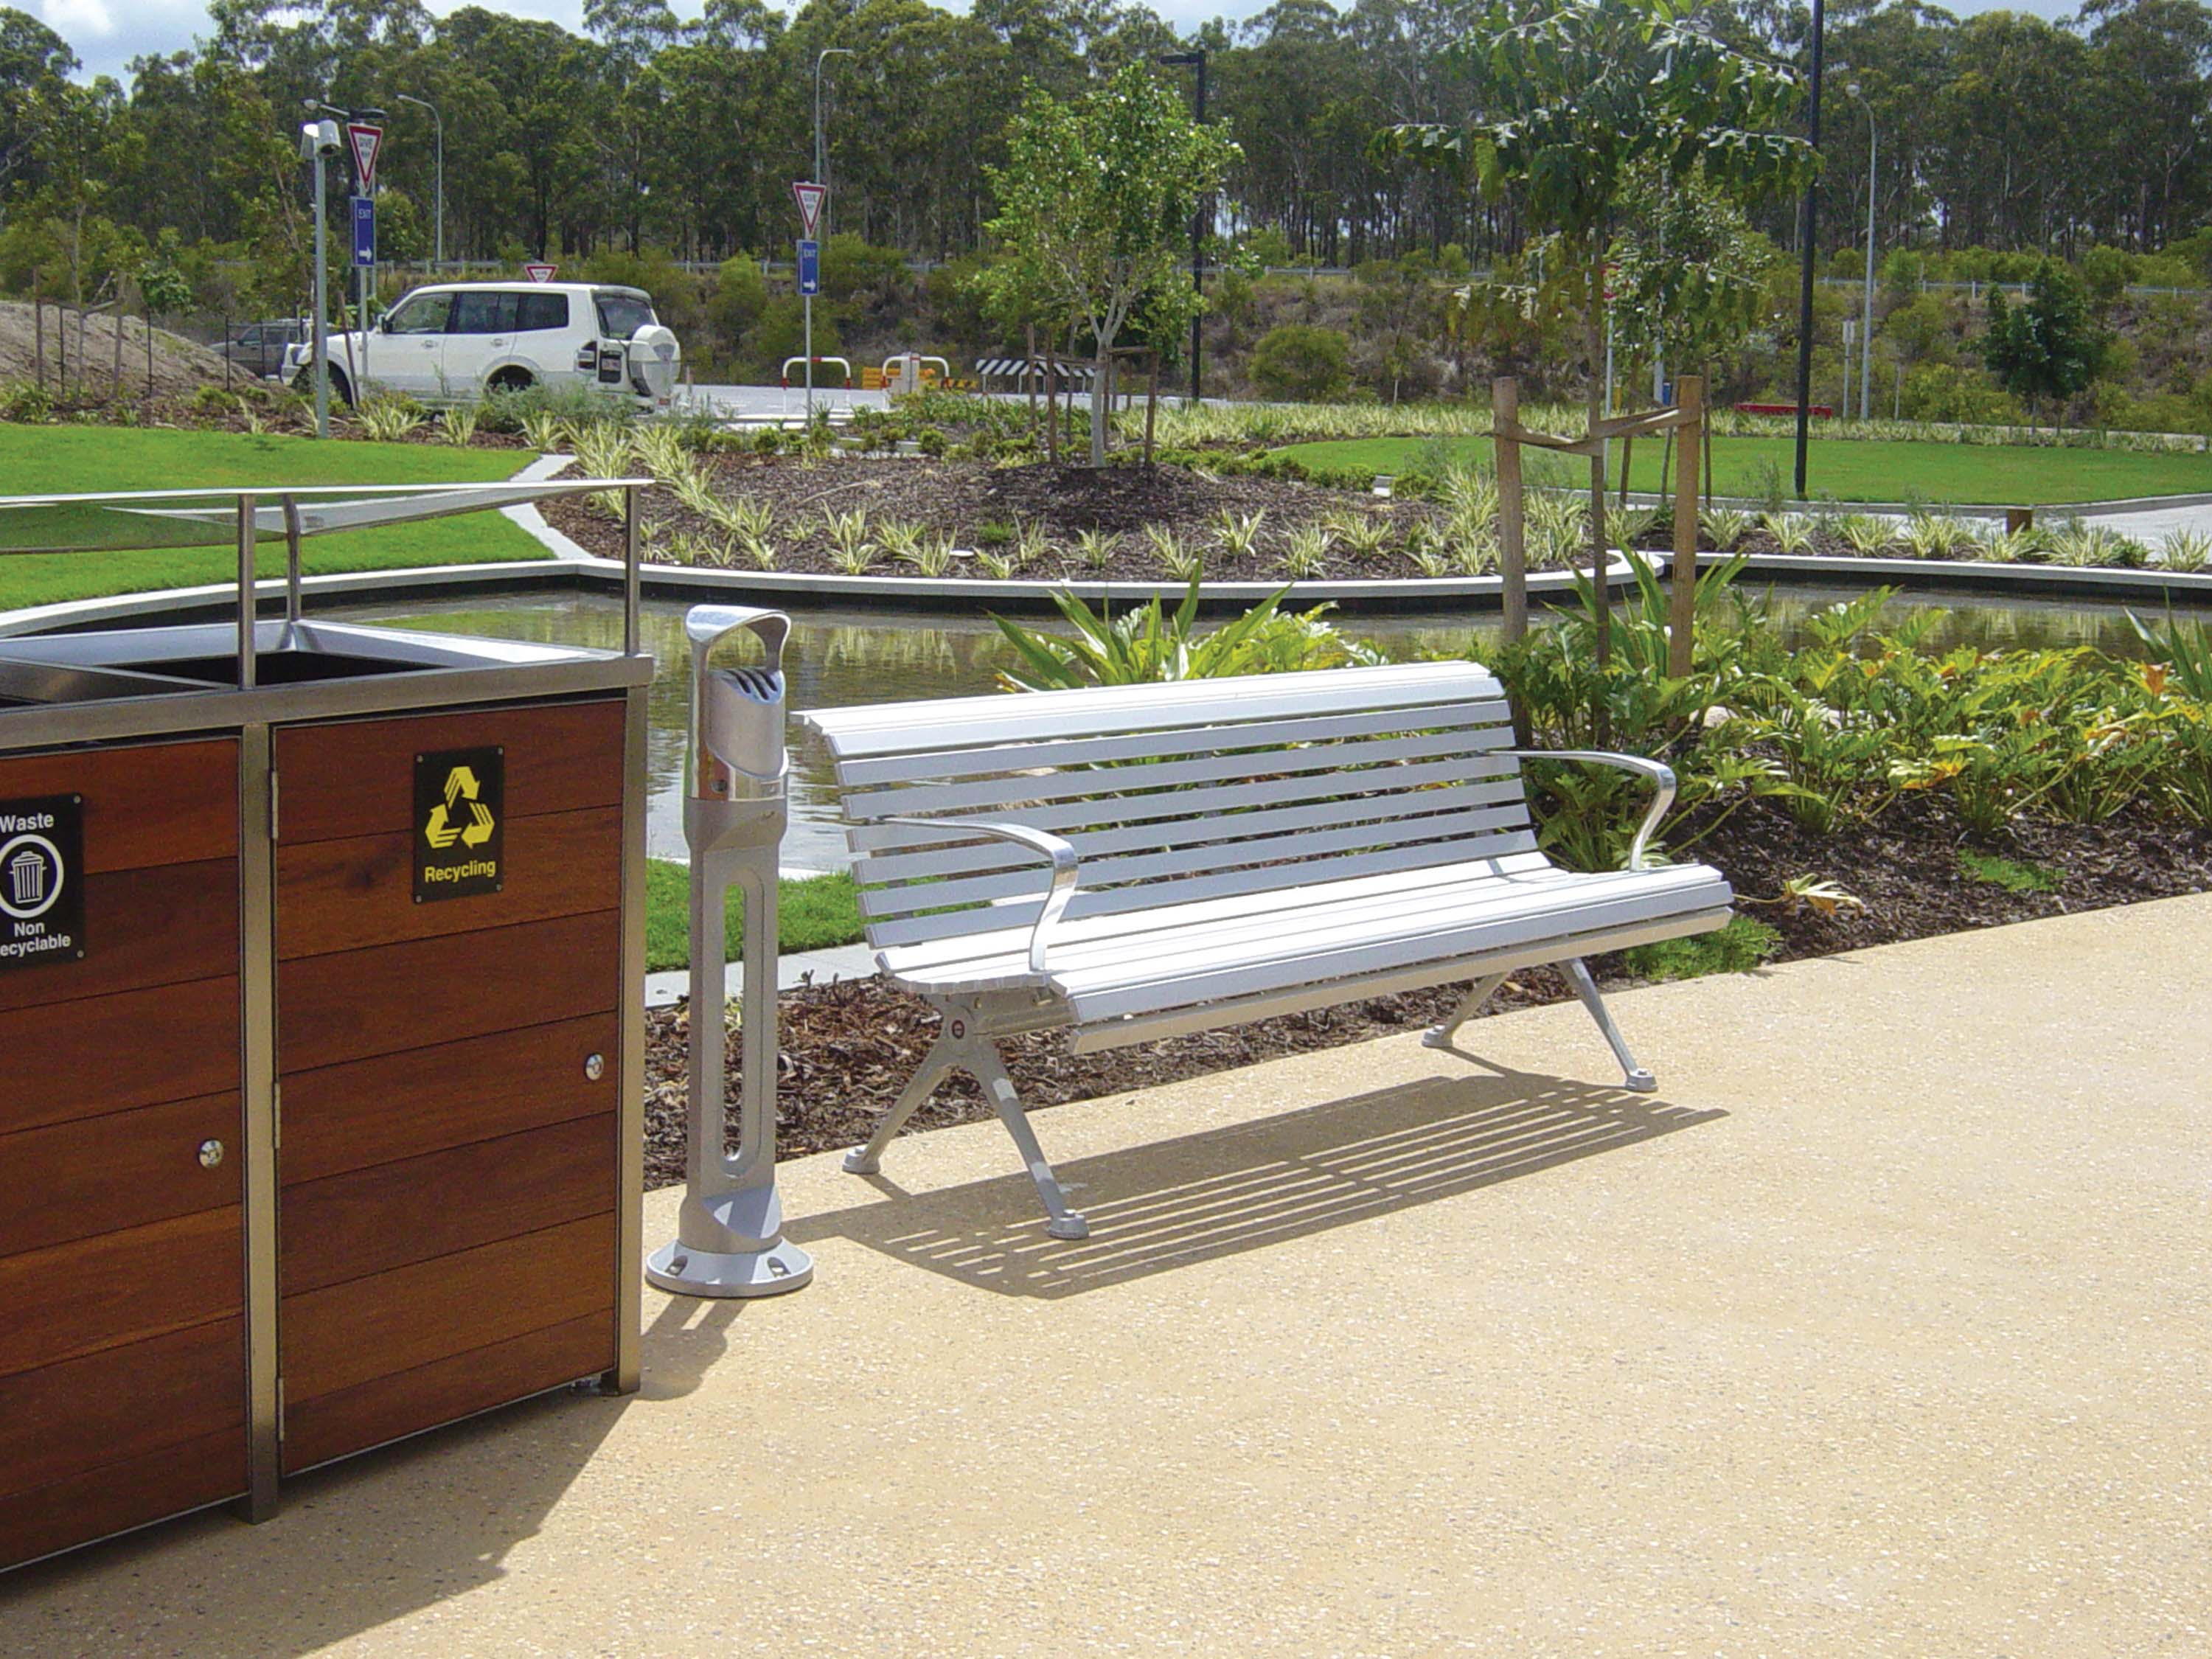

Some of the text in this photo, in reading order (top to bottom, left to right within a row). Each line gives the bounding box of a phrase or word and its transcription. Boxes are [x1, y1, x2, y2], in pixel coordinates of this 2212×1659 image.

[0, 813, 54, 833] Waste
[425, 860, 496, 884] Recycling
[14, 922, 45, 937] Non
[0, 933, 72, 958] ecyclable
